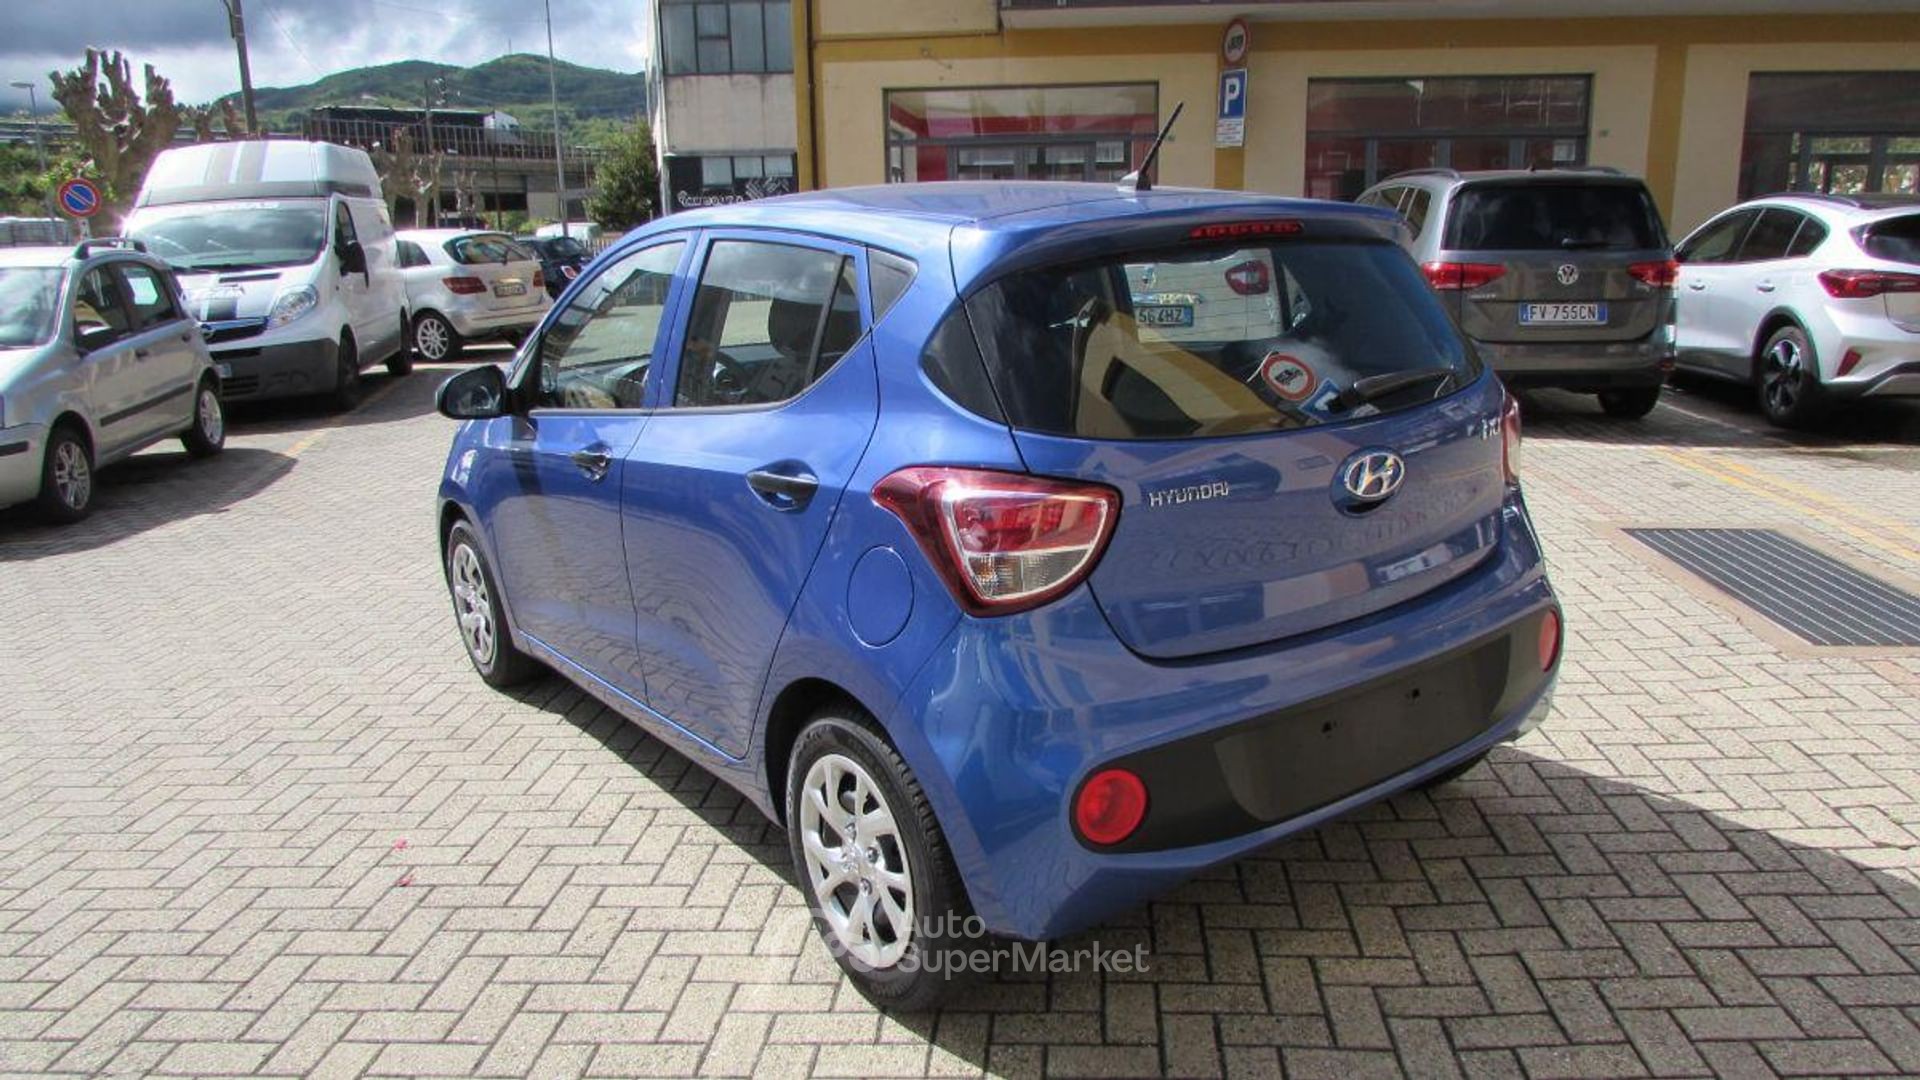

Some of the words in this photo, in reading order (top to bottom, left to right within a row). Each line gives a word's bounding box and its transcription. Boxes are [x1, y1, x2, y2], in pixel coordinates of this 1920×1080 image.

[1224, 78, 1240, 114] P
[1552, 305, 1596, 320] 755CN
[1149, 480, 1229, 507] HYUNDAI
